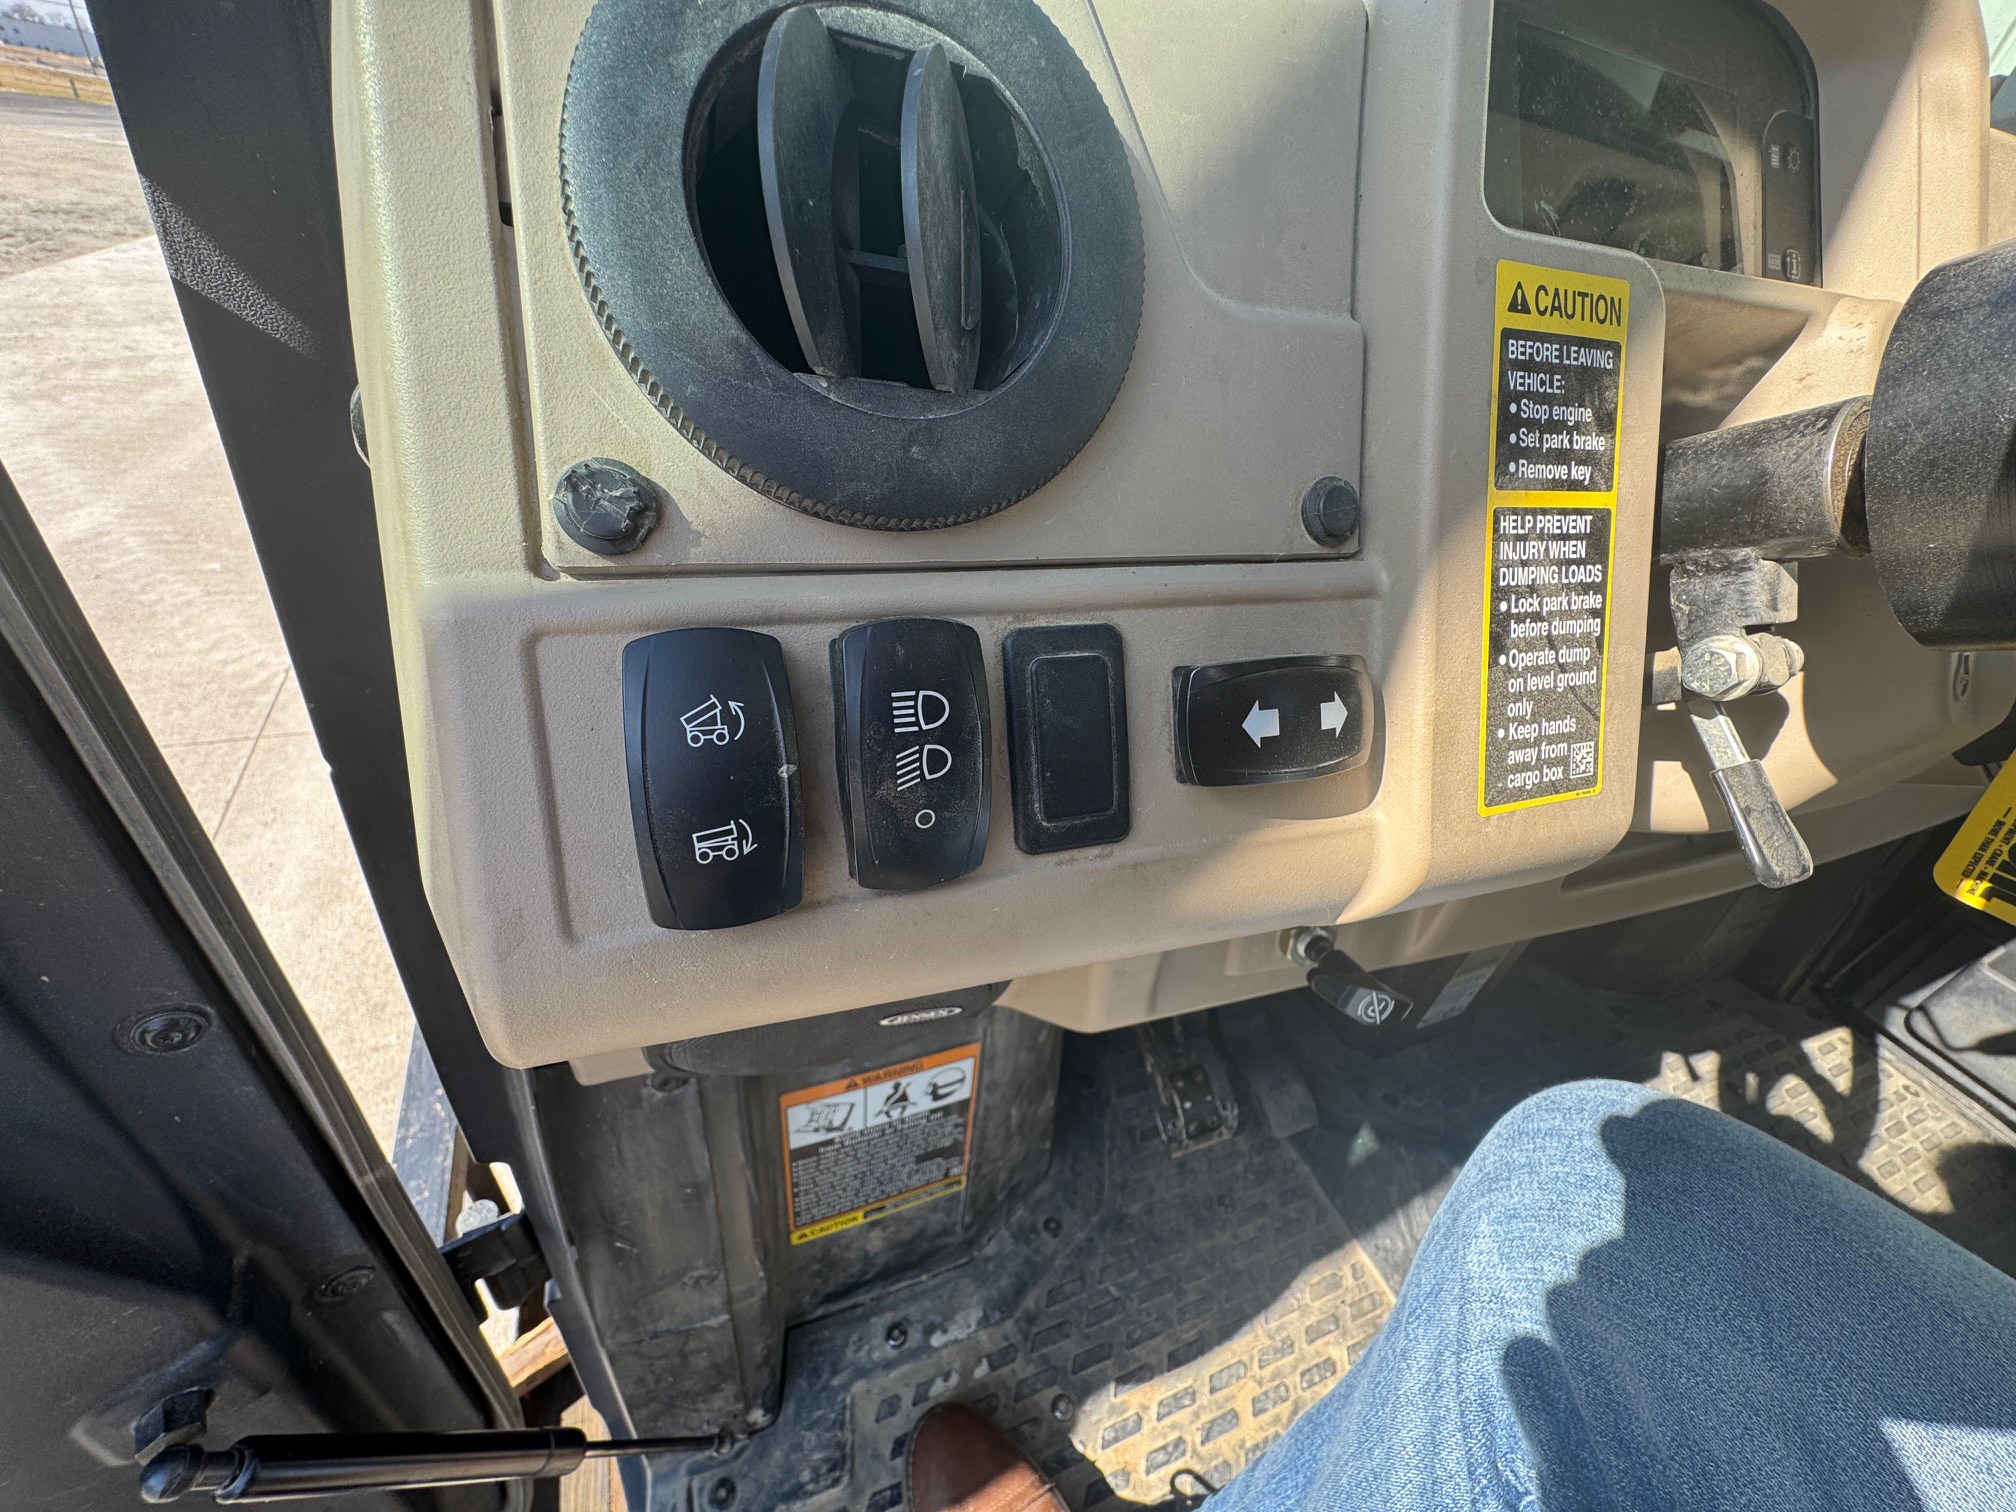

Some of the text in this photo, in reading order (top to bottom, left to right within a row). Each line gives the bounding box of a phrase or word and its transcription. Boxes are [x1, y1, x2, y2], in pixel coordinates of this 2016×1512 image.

[1534, 284, 1622, 327] CAUTION
[1508, 338, 1614, 370] BEFORE LEAVING
[1507, 370, 1566, 394] VEHICLE:
[1519, 398, 1592, 426] Stop engine
[1518, 427, 1606, 452] Set park brake
[1518, 459, 1592, 485] Remove key
[1499, 514, 1593, 534] HELP PREVENT
[1499, 539, 1586, 560] INJURY WHEN
[1499, 564, 1603, 587] DUMPING LOADS
[1510, 592, 1603, 616] Lock park brake
[1510, 617, 1601, 639] before dumping
[1508, 645, 1591, 671] Operate dump
[1508, 669, 1597, 693] on level ground
[1507, 698, 1533, 719] only
[1508, 715, 1576, 743] Keep hands
[1506, 741, 1568, 766] away from
[1506, 763, 1564, 790] cargo box
[1988, 818, 2007, 837] MORE
[1978, 836, 1996, 853] THAN
[1961, 851, 1984, 879] EXPECTED
[1985, 848, 2004, 868] CRANE
[1966, 869, 1990, 896] MACHINE
[862, 1060, 925, 1084] WARNING
[810, 1214, 860, 1237] CAUTION
